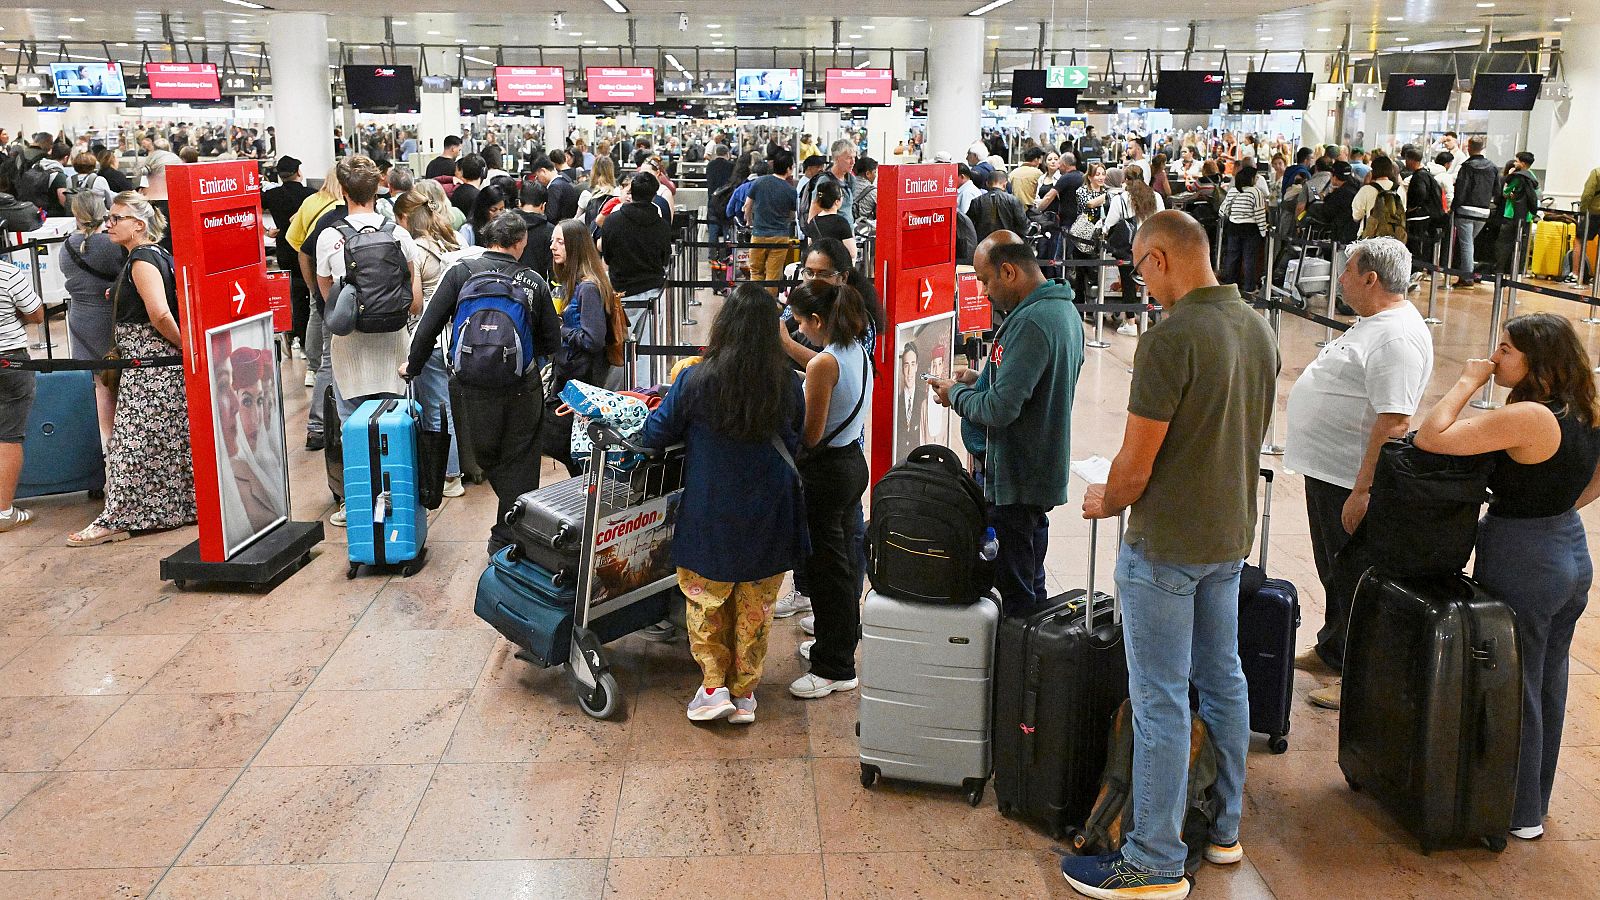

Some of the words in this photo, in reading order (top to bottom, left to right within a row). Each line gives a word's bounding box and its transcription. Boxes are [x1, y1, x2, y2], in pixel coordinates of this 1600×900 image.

[1126, 84, 1144, 94] 1.4
[199, 177, 238, 195] Emirates
[905, 177, 938, 194] Emirates
[204, 216, 224, 229] Online
[908, 215, 932, 227] Economy
[932, 212, 945, 223] Class
[596, 510, 658, 546] corendon
